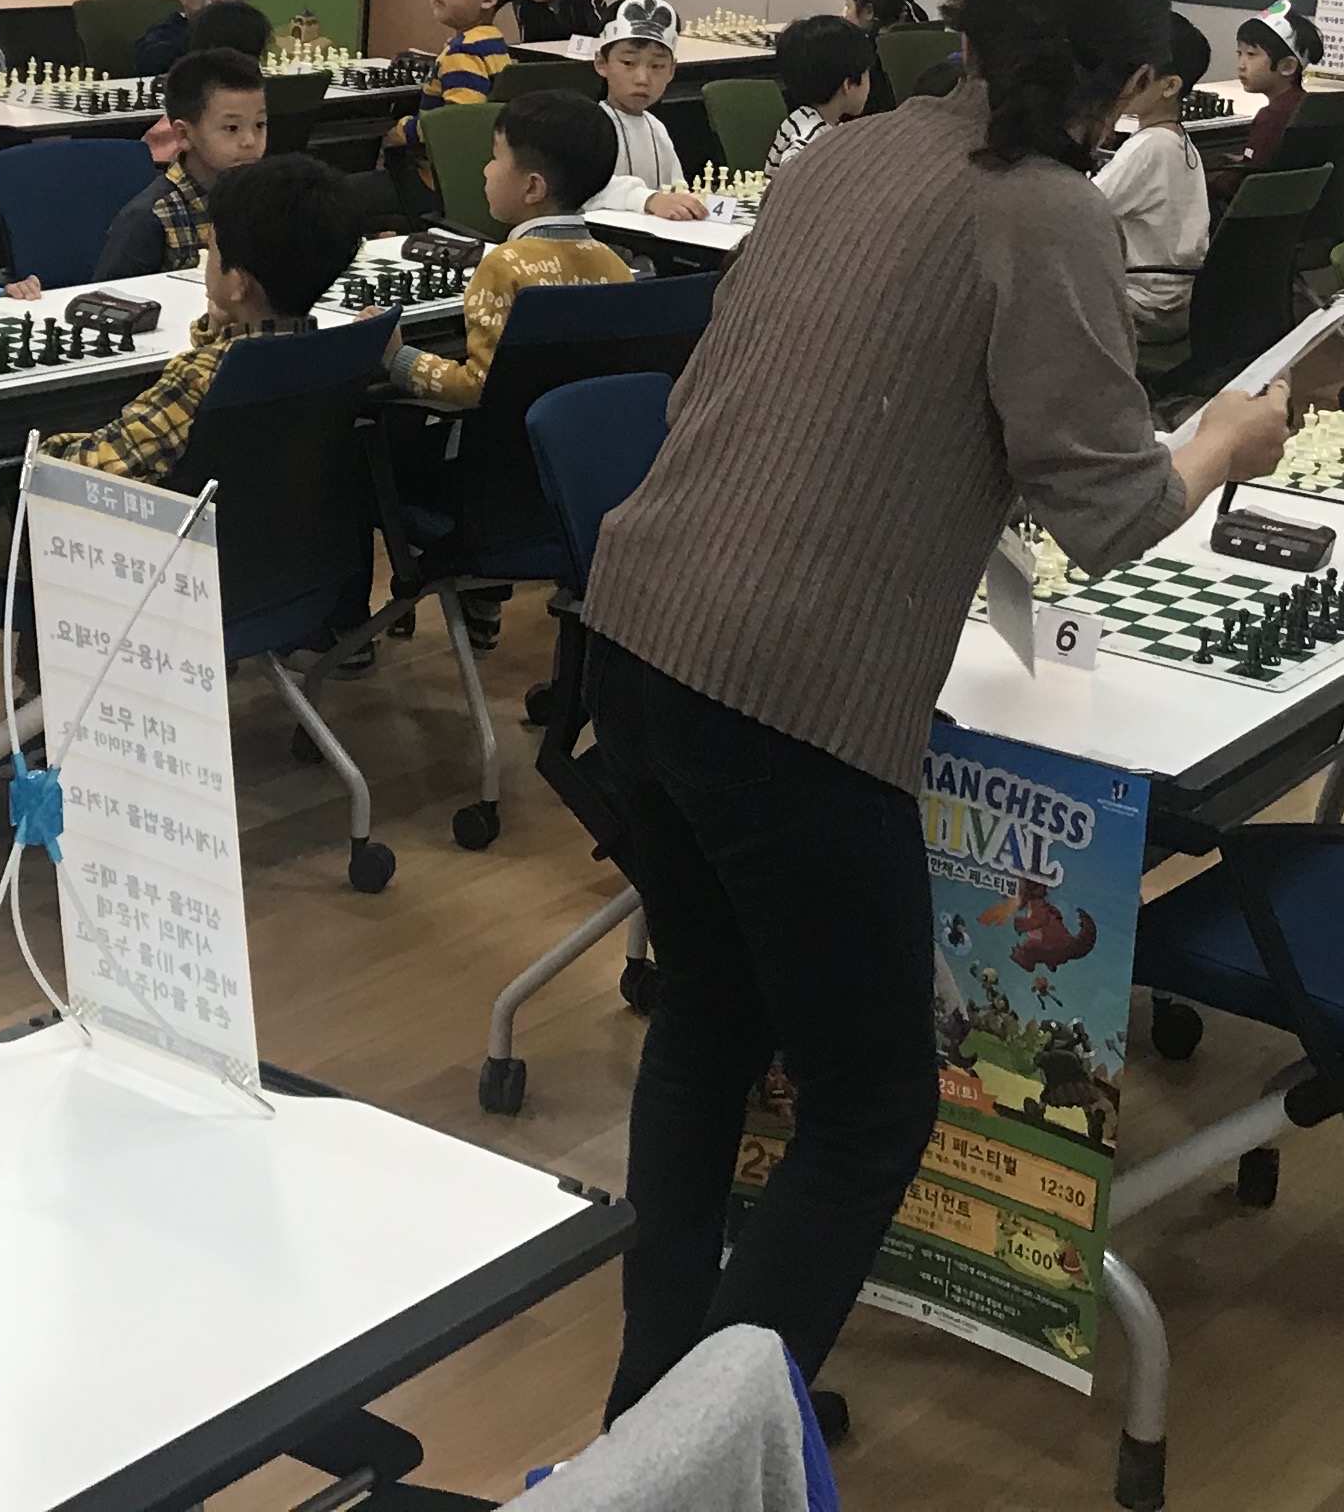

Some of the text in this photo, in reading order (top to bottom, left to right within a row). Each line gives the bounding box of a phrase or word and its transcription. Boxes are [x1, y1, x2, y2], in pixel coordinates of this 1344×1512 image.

[16, 88, 27, 103] 2
[712, 200, 725, 217] 4
[1055, 620, 1080, 652] 6
[921, 796, 1062, 880] TIVAL
[930, 859, 1018, 896] 만체스 페스티벌
[938, 1078, 979, 1101] 23(토)
[929, 1131, 1086, 1207] 리 페스티벌 12:30
[907, 1183, 971, 1219] 토너먼트
[1007, 1239, 1053, 1270] 14:00
